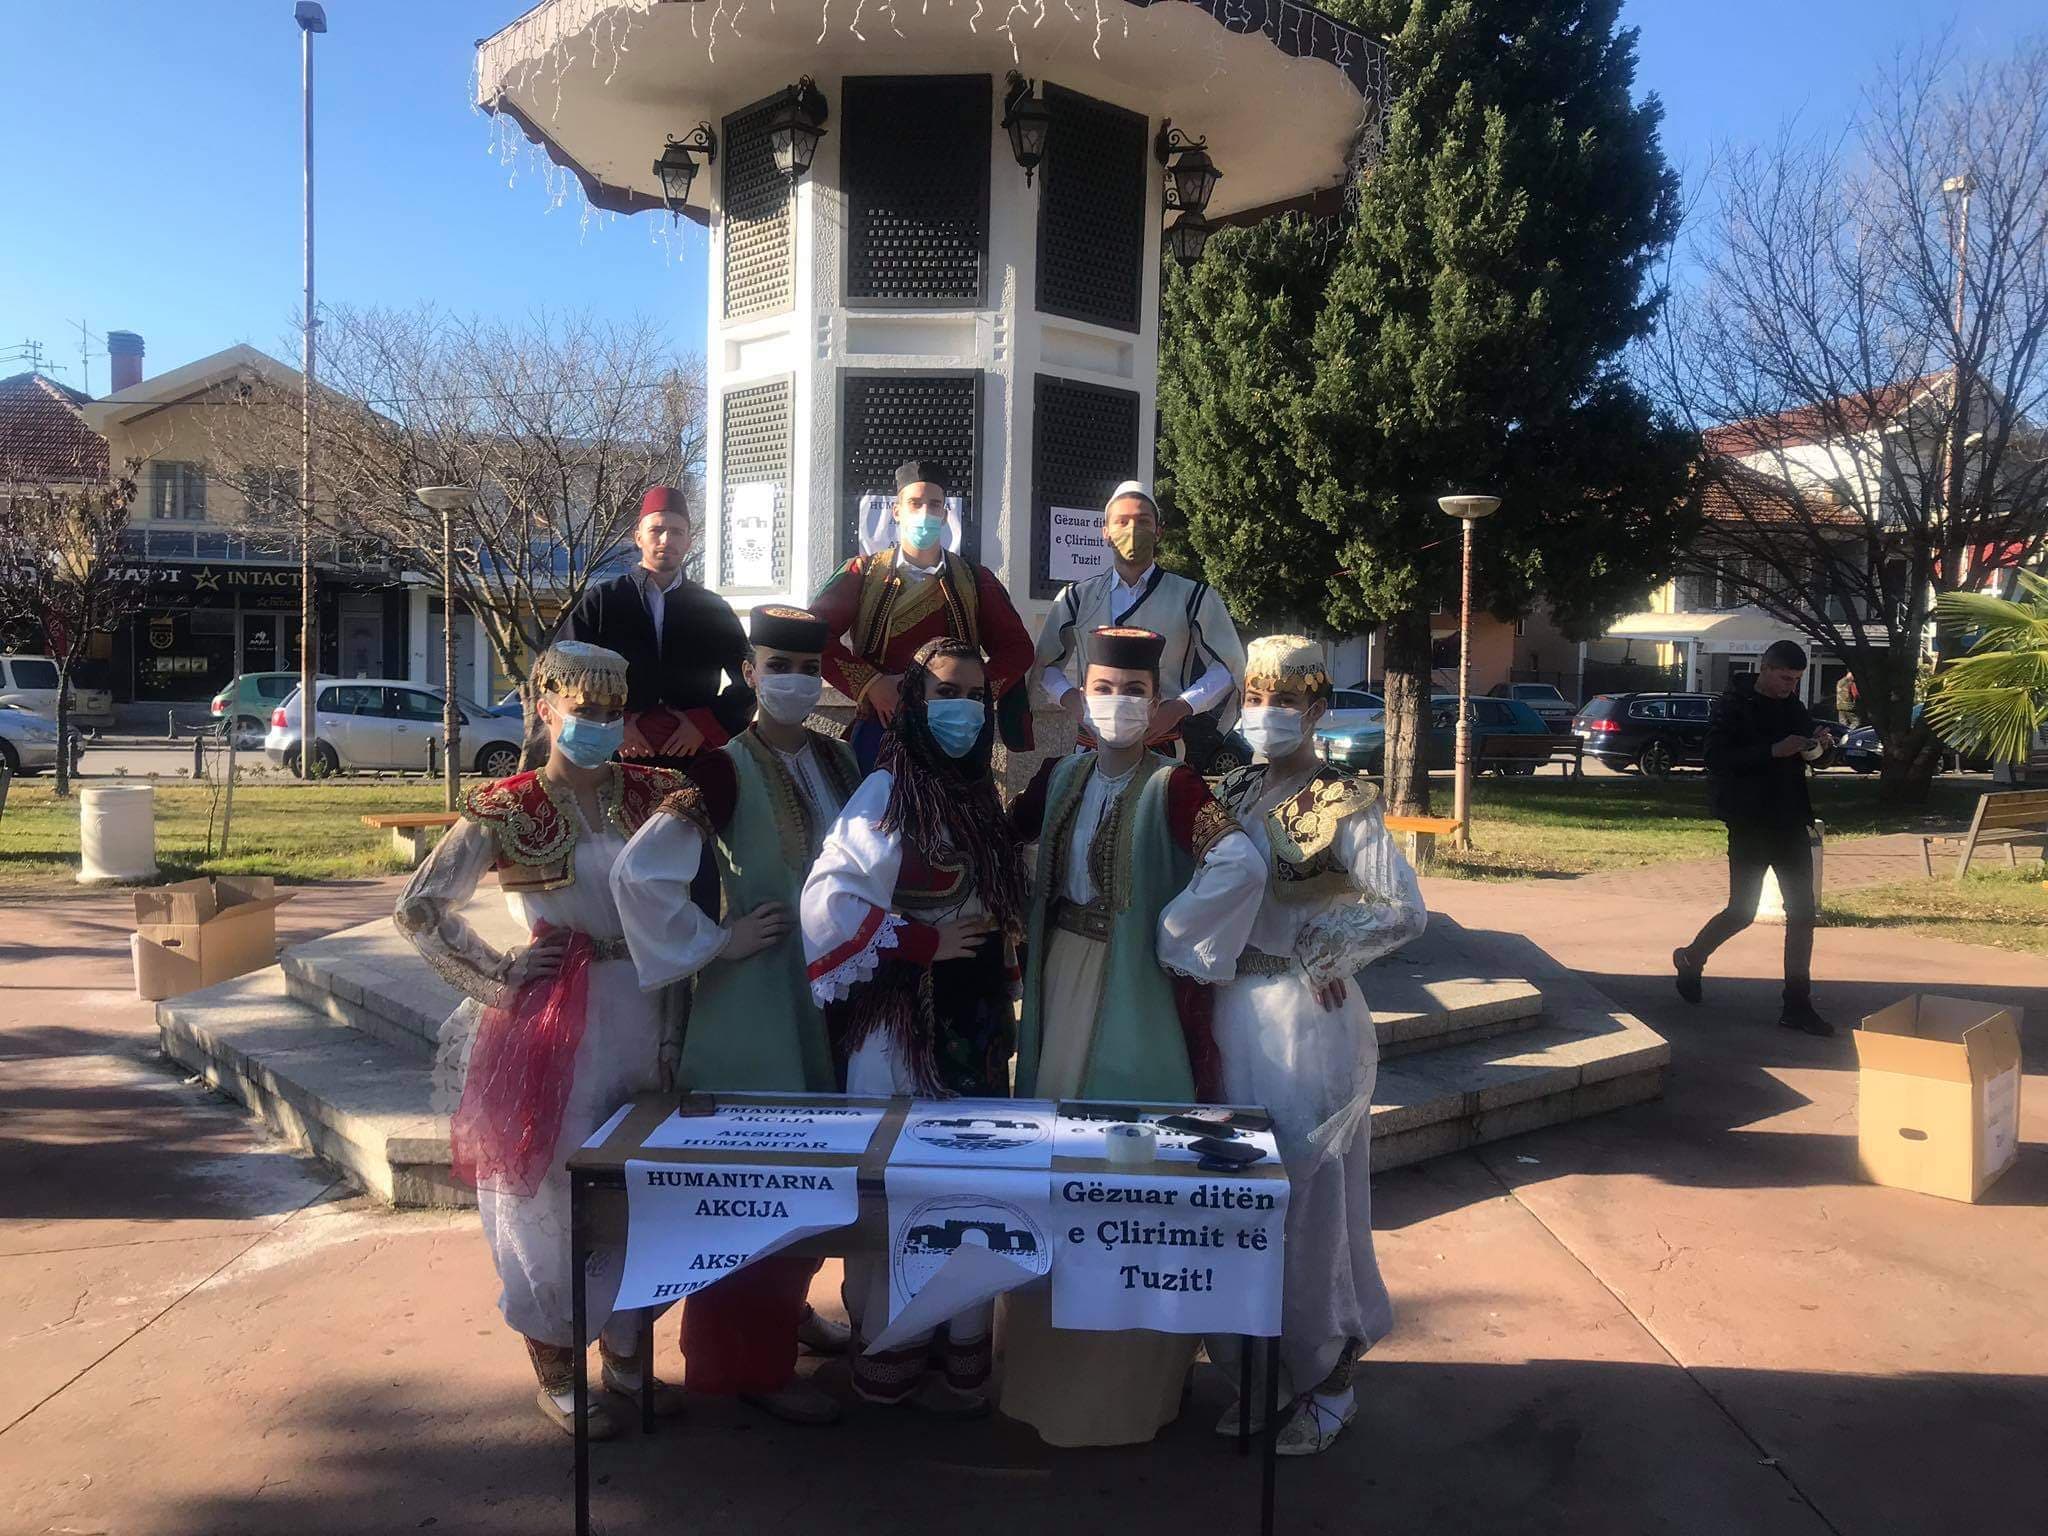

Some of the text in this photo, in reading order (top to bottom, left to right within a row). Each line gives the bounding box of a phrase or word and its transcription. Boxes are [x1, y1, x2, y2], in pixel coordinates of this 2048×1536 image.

[1054, 514, 1091, 528] Gëzuar
[1055, 535, 1062, 544] e
[1065, 534, 1104, 547] Çlirimit
[1071, 553, 1101, 566] Tuzit!
[228, 571, 317, 587] INTACT
[715, 1106, 863, 1116] UMANITARNA
[729, 1115, 816, 1124] AKCIJA
[716, 1130, 807, 1138] AKSION
[682, 1139, 829, 1149] HUMANITAR
[647, 1170, 835, 1191] HUMANITARNA
[1062, 1181, 1275, 1210] Gëzuar ditën
[695, 1199, 789, 1218] AKCIJA
[1068, 1220, 1268, 1251] e Çlirimit të
[1120, 1264, 1213, 1292] Tuzit!
